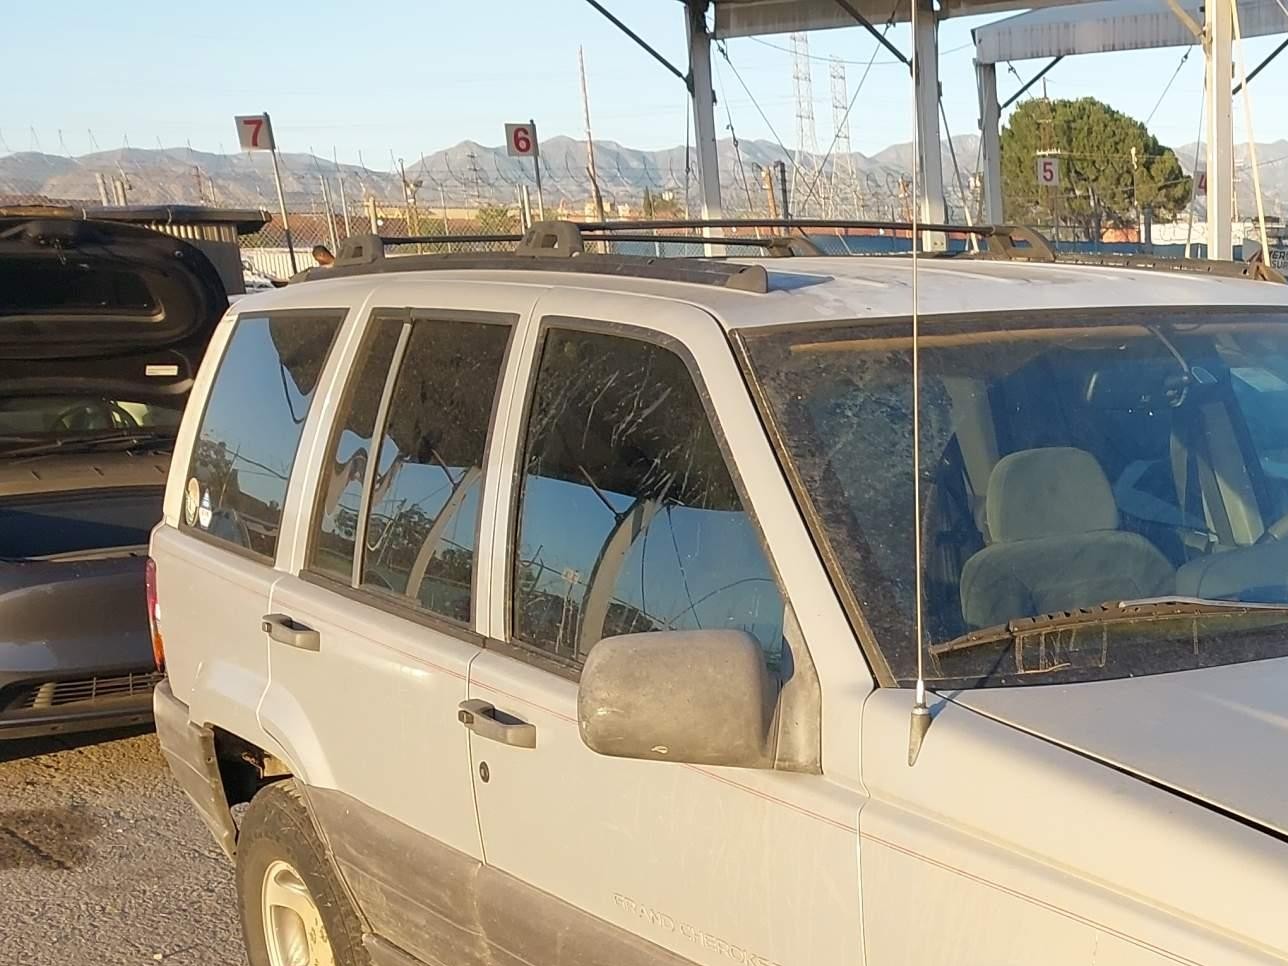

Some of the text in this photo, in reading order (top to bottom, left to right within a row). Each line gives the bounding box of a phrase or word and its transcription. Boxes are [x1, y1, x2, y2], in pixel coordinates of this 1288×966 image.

[243, 119, 263, 147] 7
[514, 127, 531, 153] 6
[1043, 161, 1054, 182] 5
[613, 893, 675, 932] GRAND
